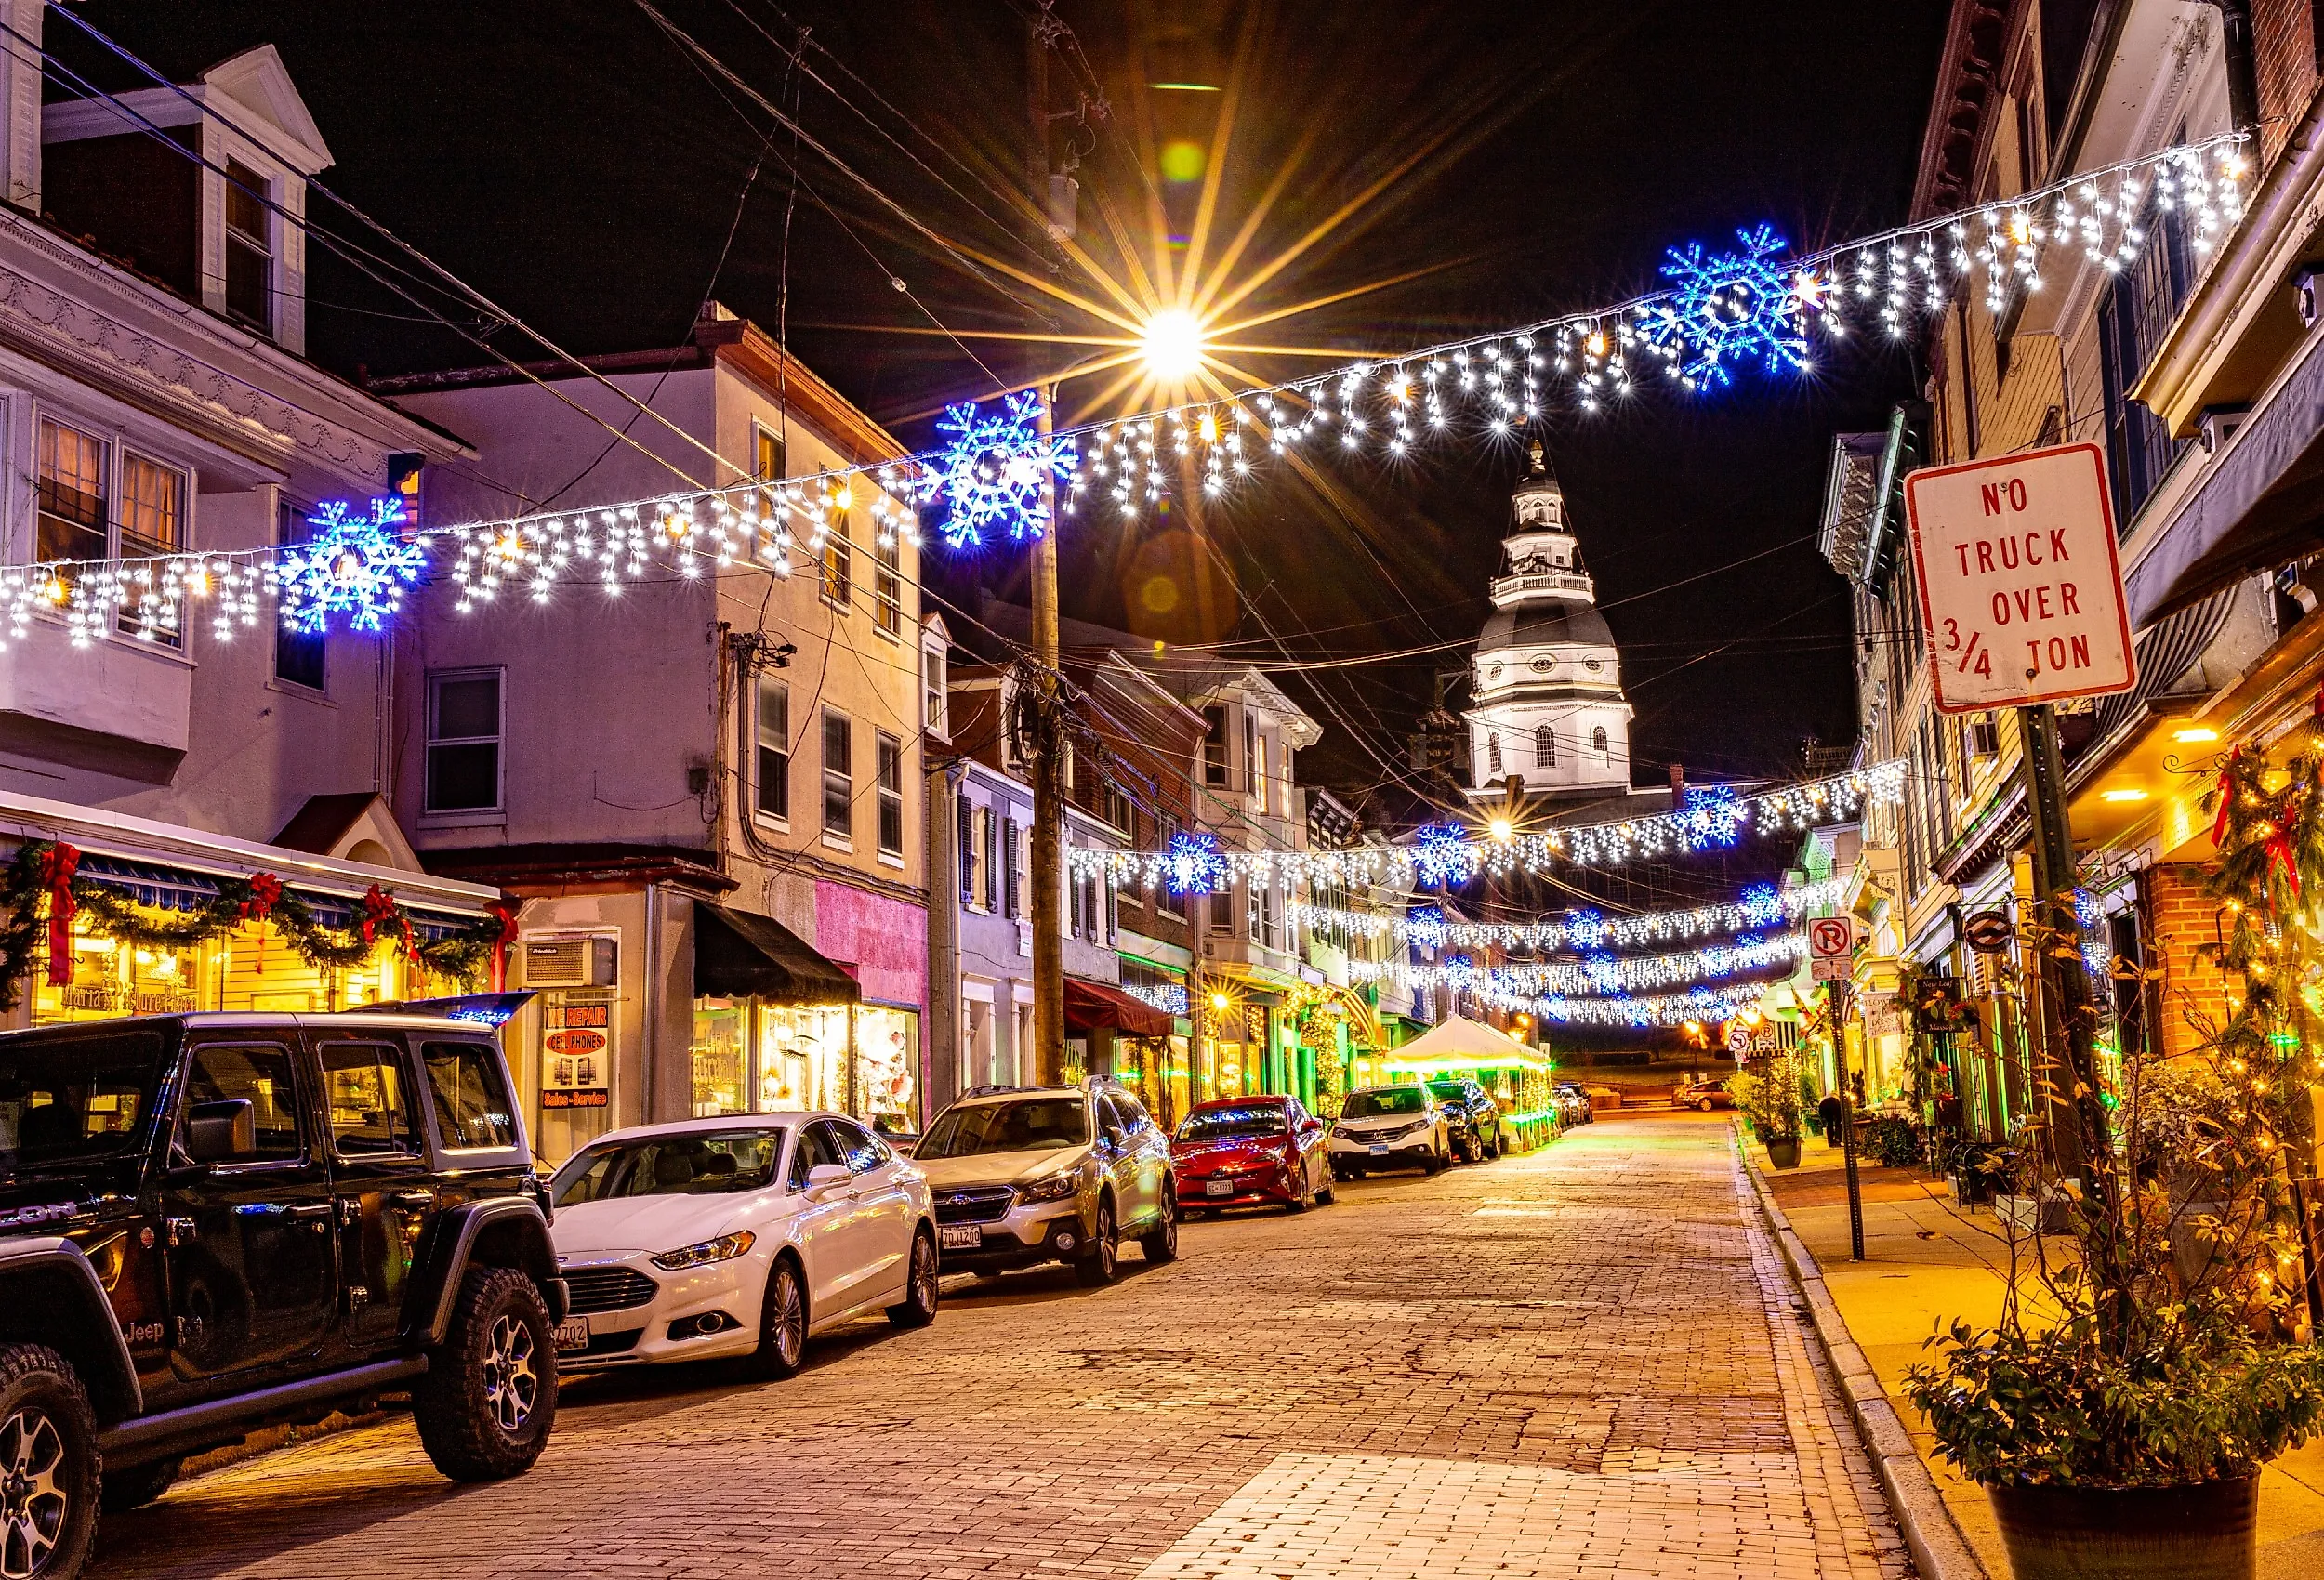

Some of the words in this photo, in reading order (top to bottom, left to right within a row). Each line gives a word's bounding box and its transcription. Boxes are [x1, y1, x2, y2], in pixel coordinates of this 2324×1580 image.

[1981, 478, 2027, 517] NO
[1954, 528, 2070, 577] TRUCK
[1992, 582, 2080, 626] OVER
[1943, 618, 1992, 680] 3/4
[2027, 634, 2091, 675] TON
[1938, 980, 1953, 989] Leaf
[165, 985, 197, 1013] Place
[547, 1007, 565, 1027] WE
[566, 1007, 607, 1027] REPAIR
[550, 1036, 569, 1049] CELL
[571, 1034, 601, 1049] PHONES
[125, 1322, 165, 1343] Jeep
